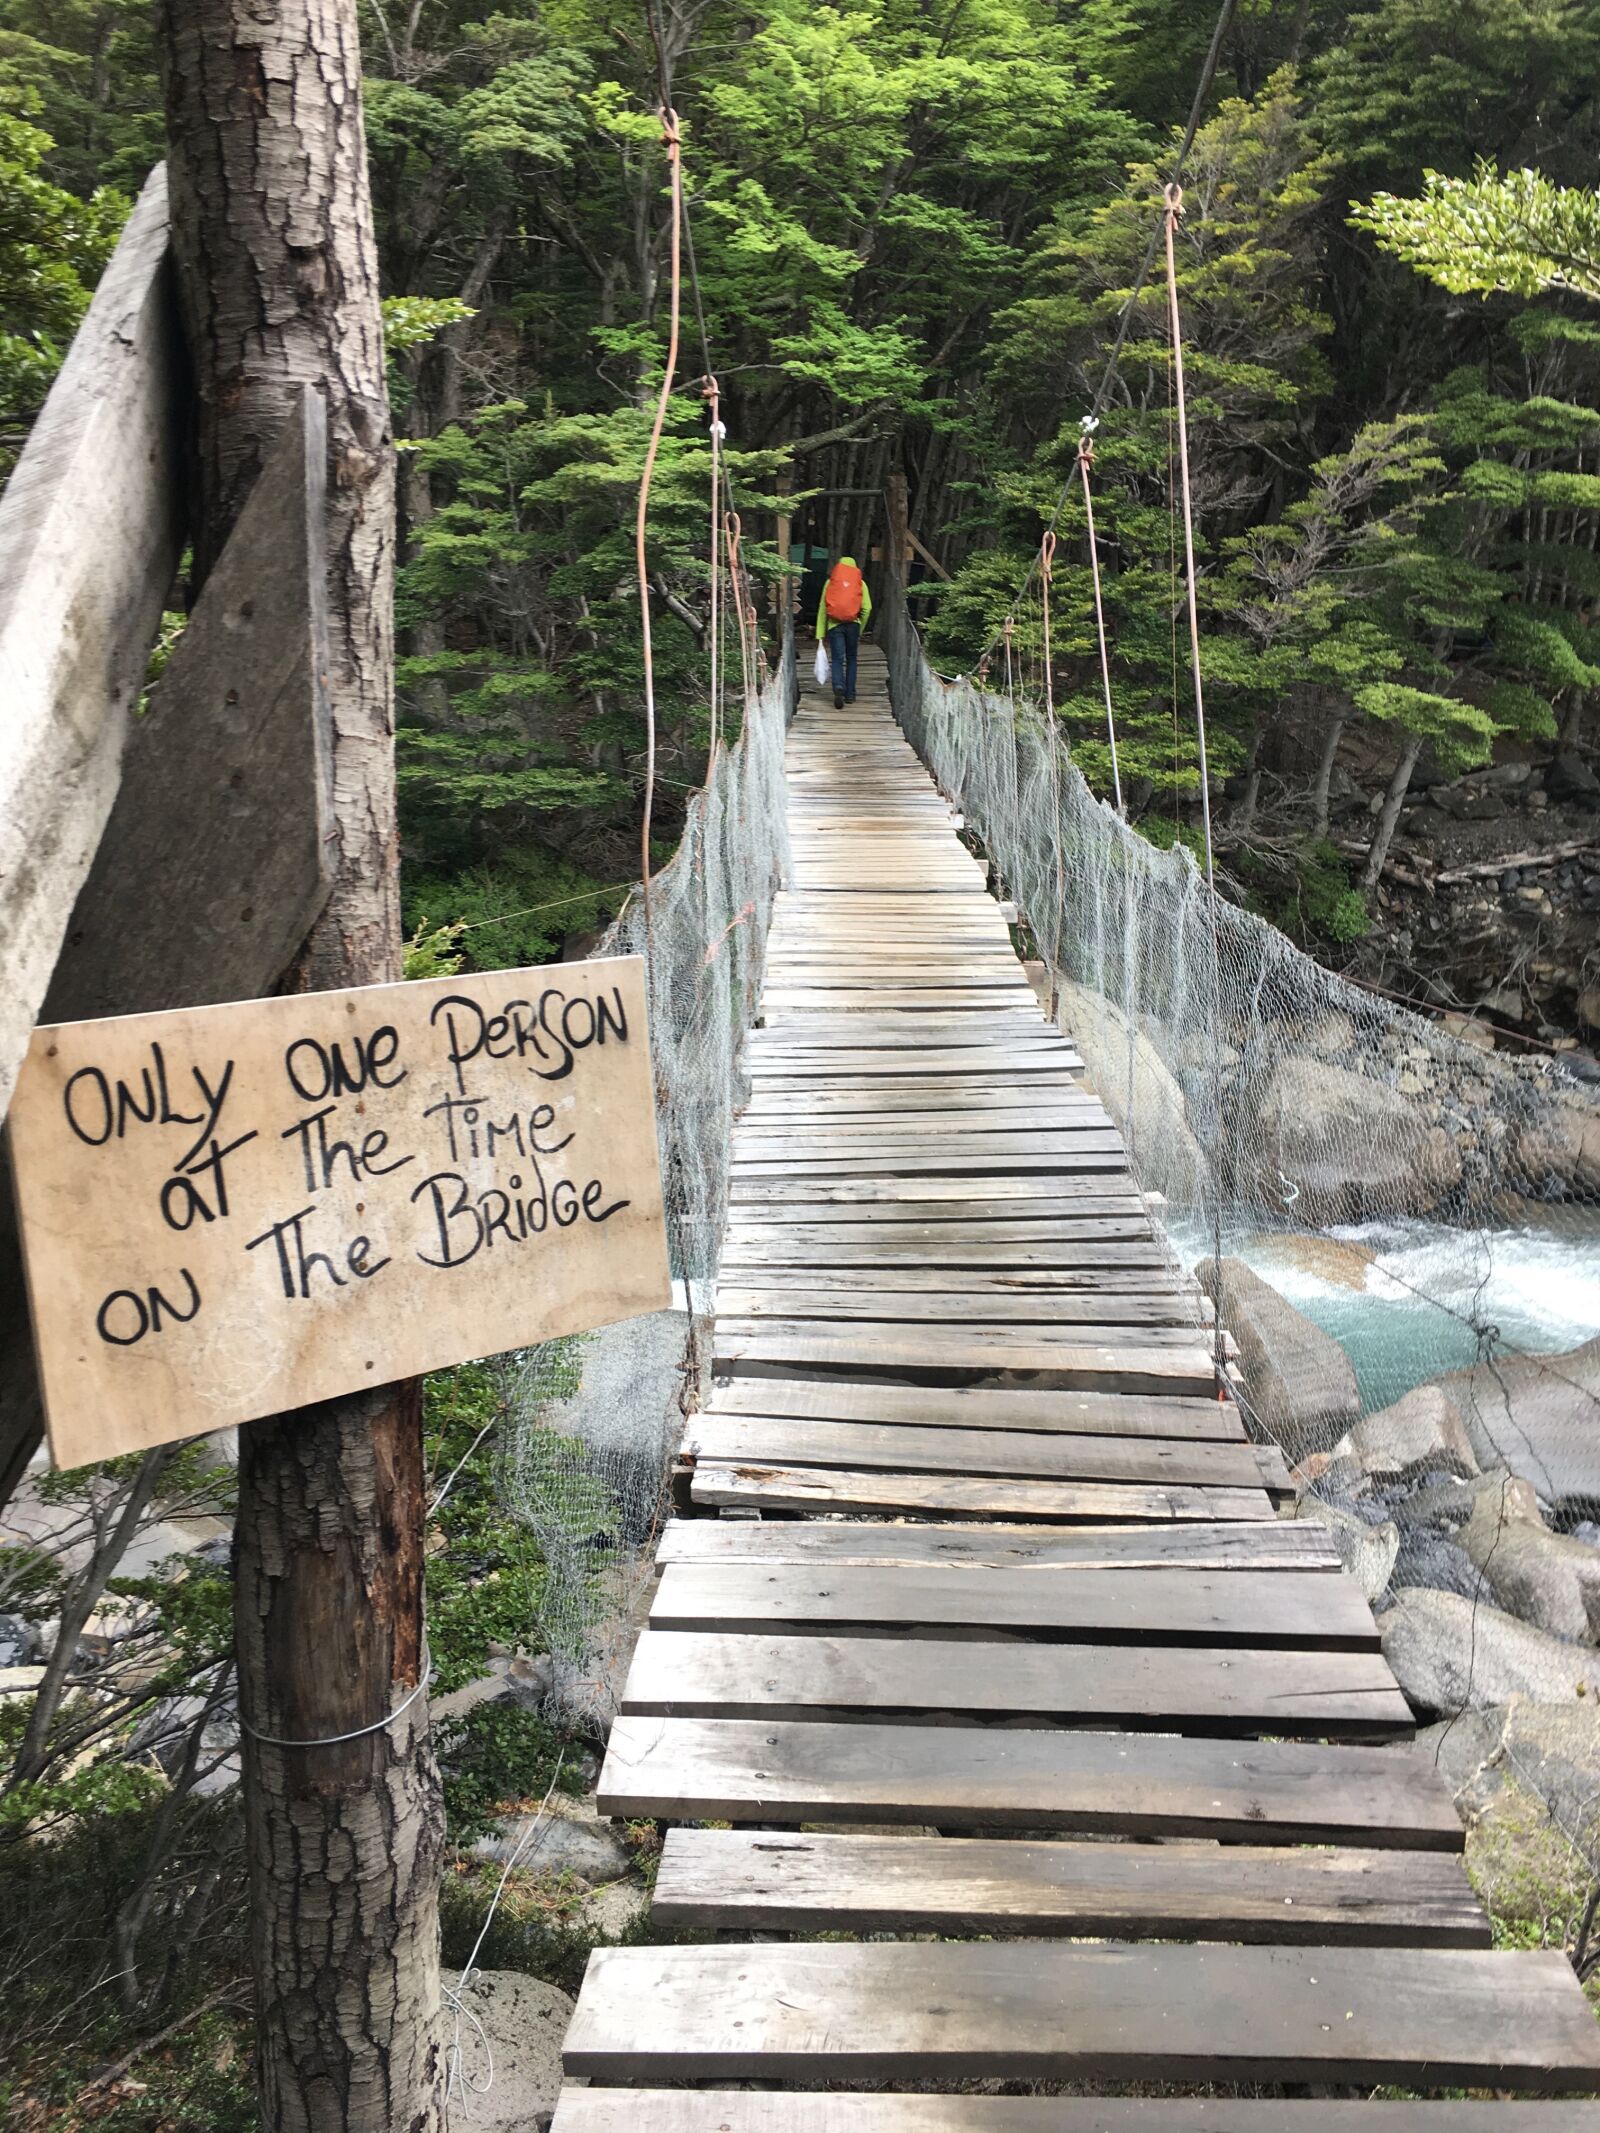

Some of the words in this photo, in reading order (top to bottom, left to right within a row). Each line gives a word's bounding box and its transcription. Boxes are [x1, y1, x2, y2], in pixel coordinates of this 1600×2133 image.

[282, 1105, 416, 1193] The
[97, 1268, 202, 1346] ON
[246, 1206, 393, 1299] The
